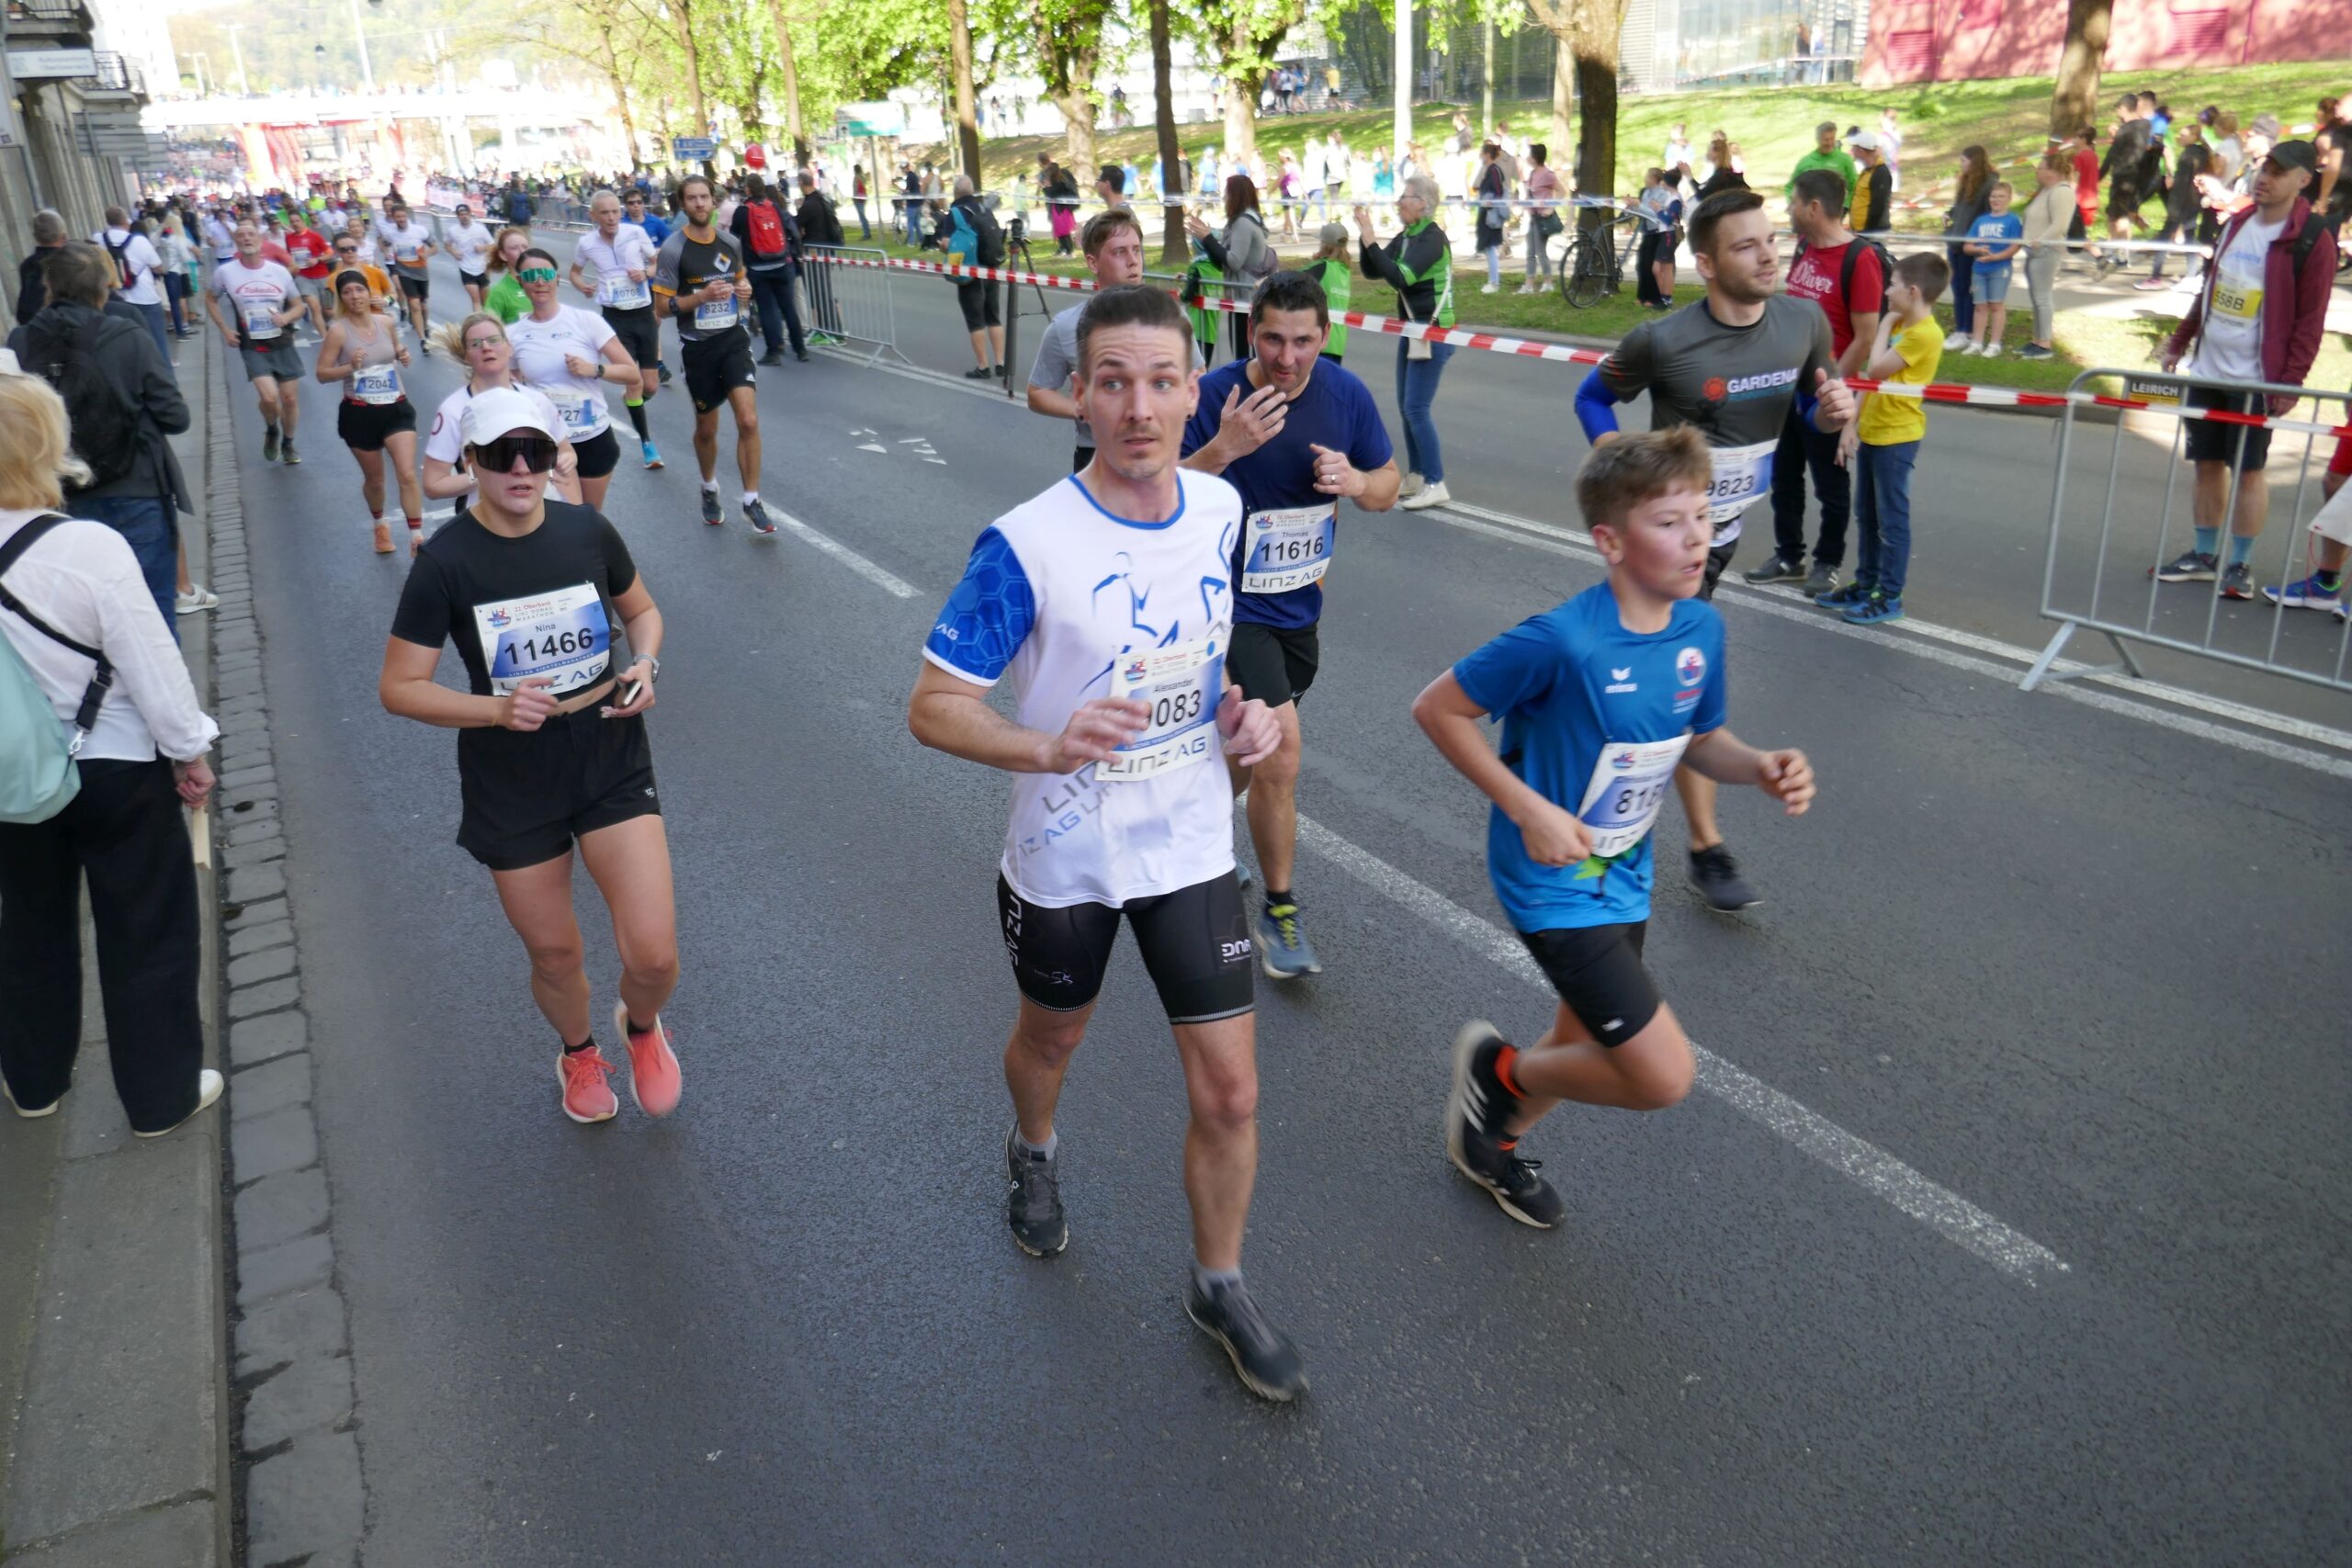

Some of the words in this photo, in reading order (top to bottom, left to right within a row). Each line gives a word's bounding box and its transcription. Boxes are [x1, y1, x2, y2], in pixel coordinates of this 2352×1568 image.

[705, 302, 729, 313] 8232
[2132, 382, 2178, 397] LEIRICH
[1706, 475, 1754, 497] 9823
[1260, 536, 1323, 562] 11616
[1250, 575, 1296, 588] LINZ
[1300, 567, 1323, 583] AG
[535, 624, 556, 633] Nina
[504, 627, 594, 665] 11466
[570, 661, 604, 684] AG
[1148, 689, 1201, 727] 083
[1174, 736, 1206, 761] AG
